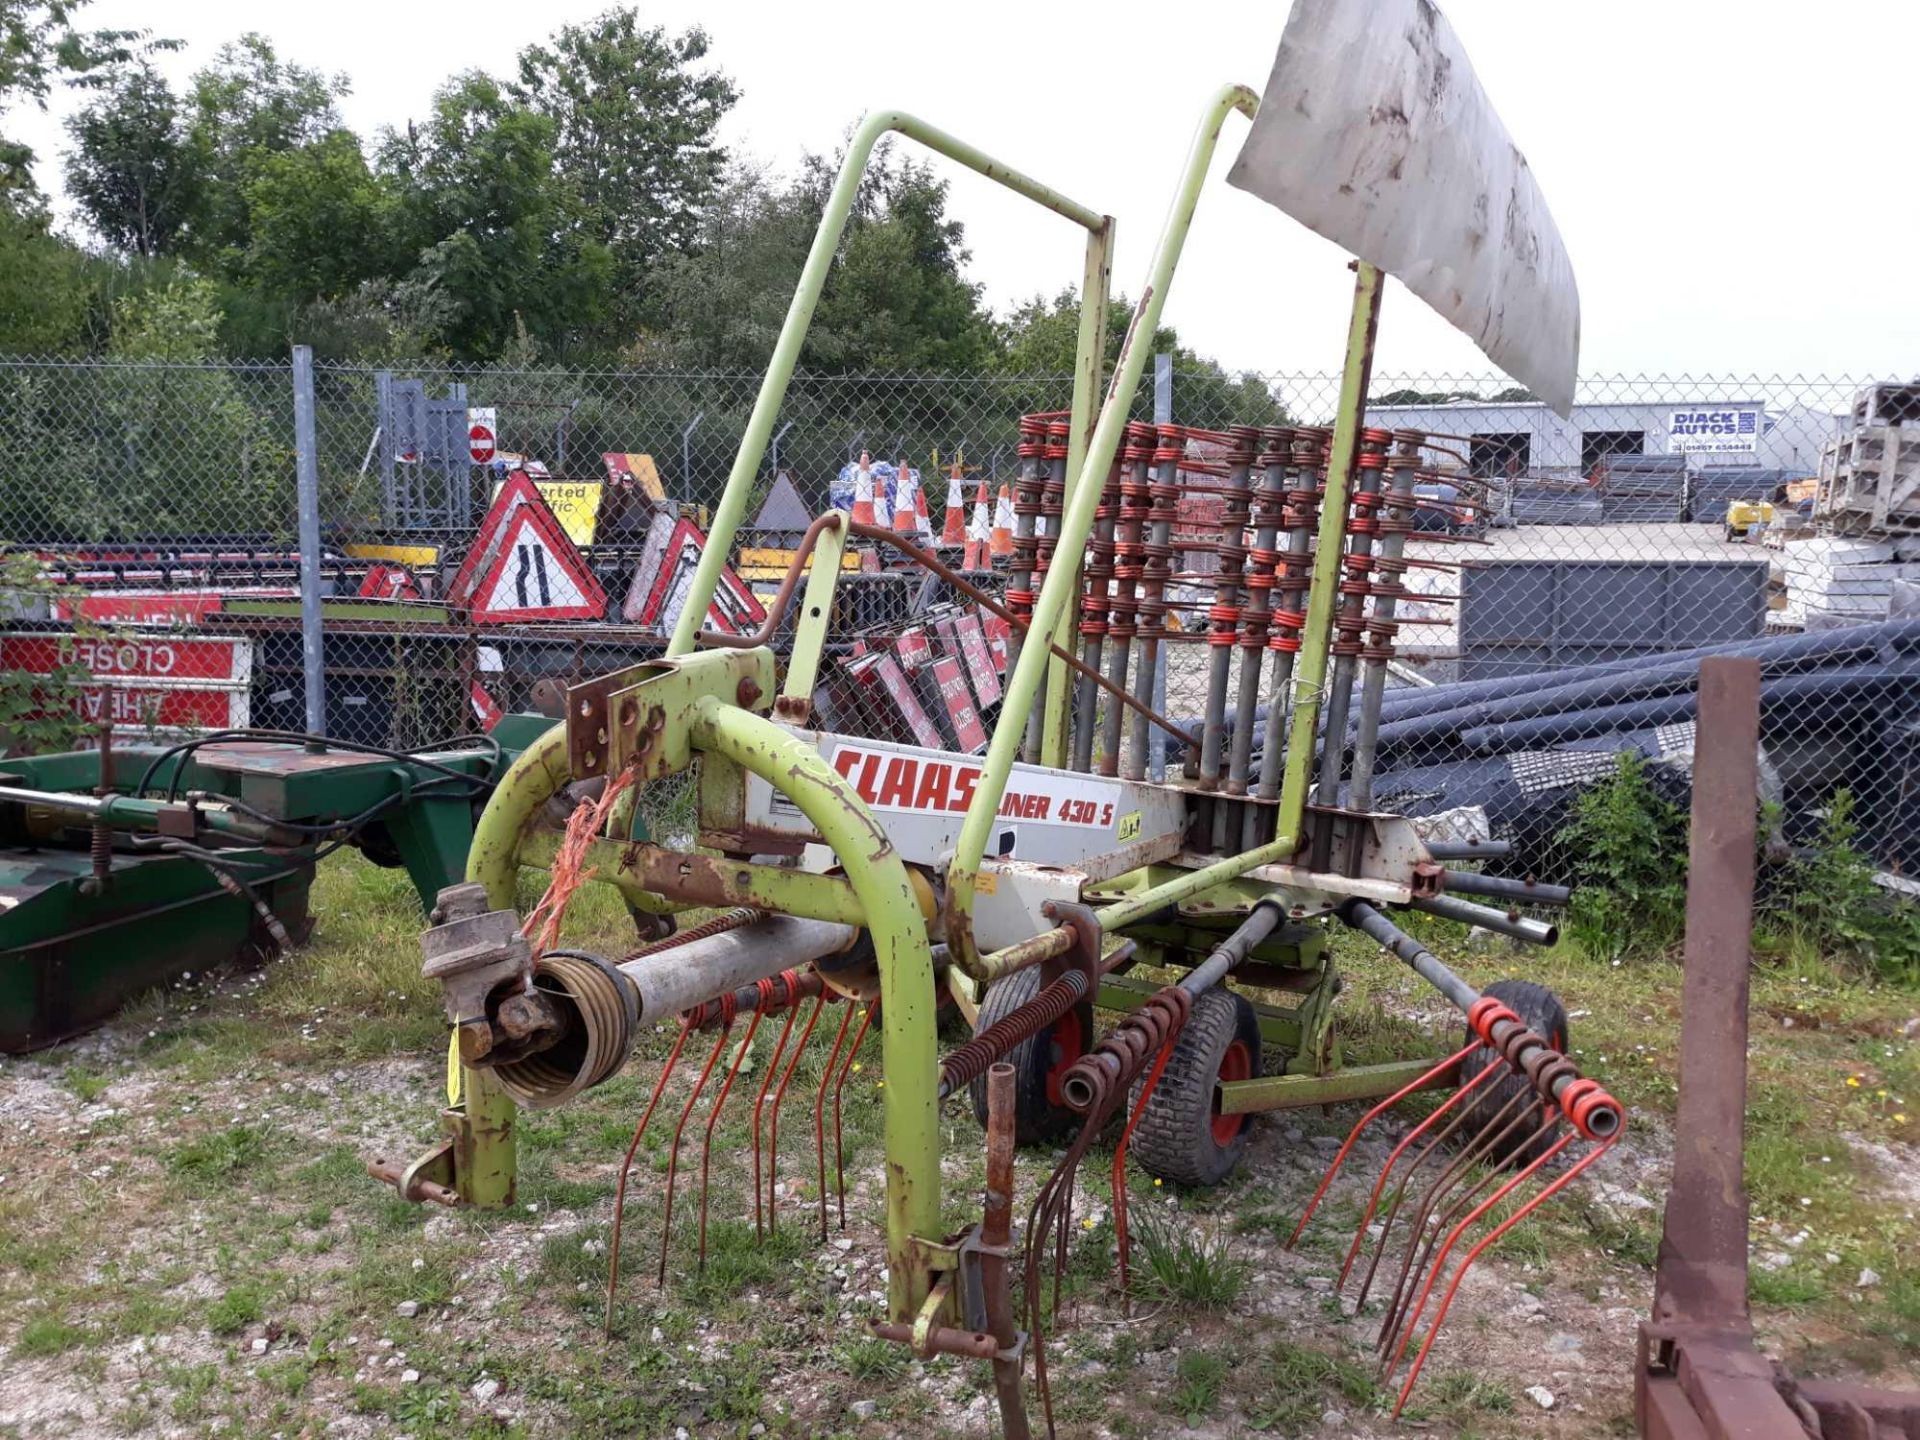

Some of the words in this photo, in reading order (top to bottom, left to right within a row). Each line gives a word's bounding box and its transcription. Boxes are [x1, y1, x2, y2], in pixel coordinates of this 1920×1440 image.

[1674, 413, 1734, 423] DIACK
[1671, 424, 1737, 435] AUTOS
[539, 485, 586, 498] erted
[545, 499, 573, 512] fic
[75, 690, 166, 720] AHEA
[834, 750, 983, 813] CLAAS
[994, 792, 1051, 820] INER
[1058, 798, 1098, 824] 430
[1099, 803, 1114, 826] S
